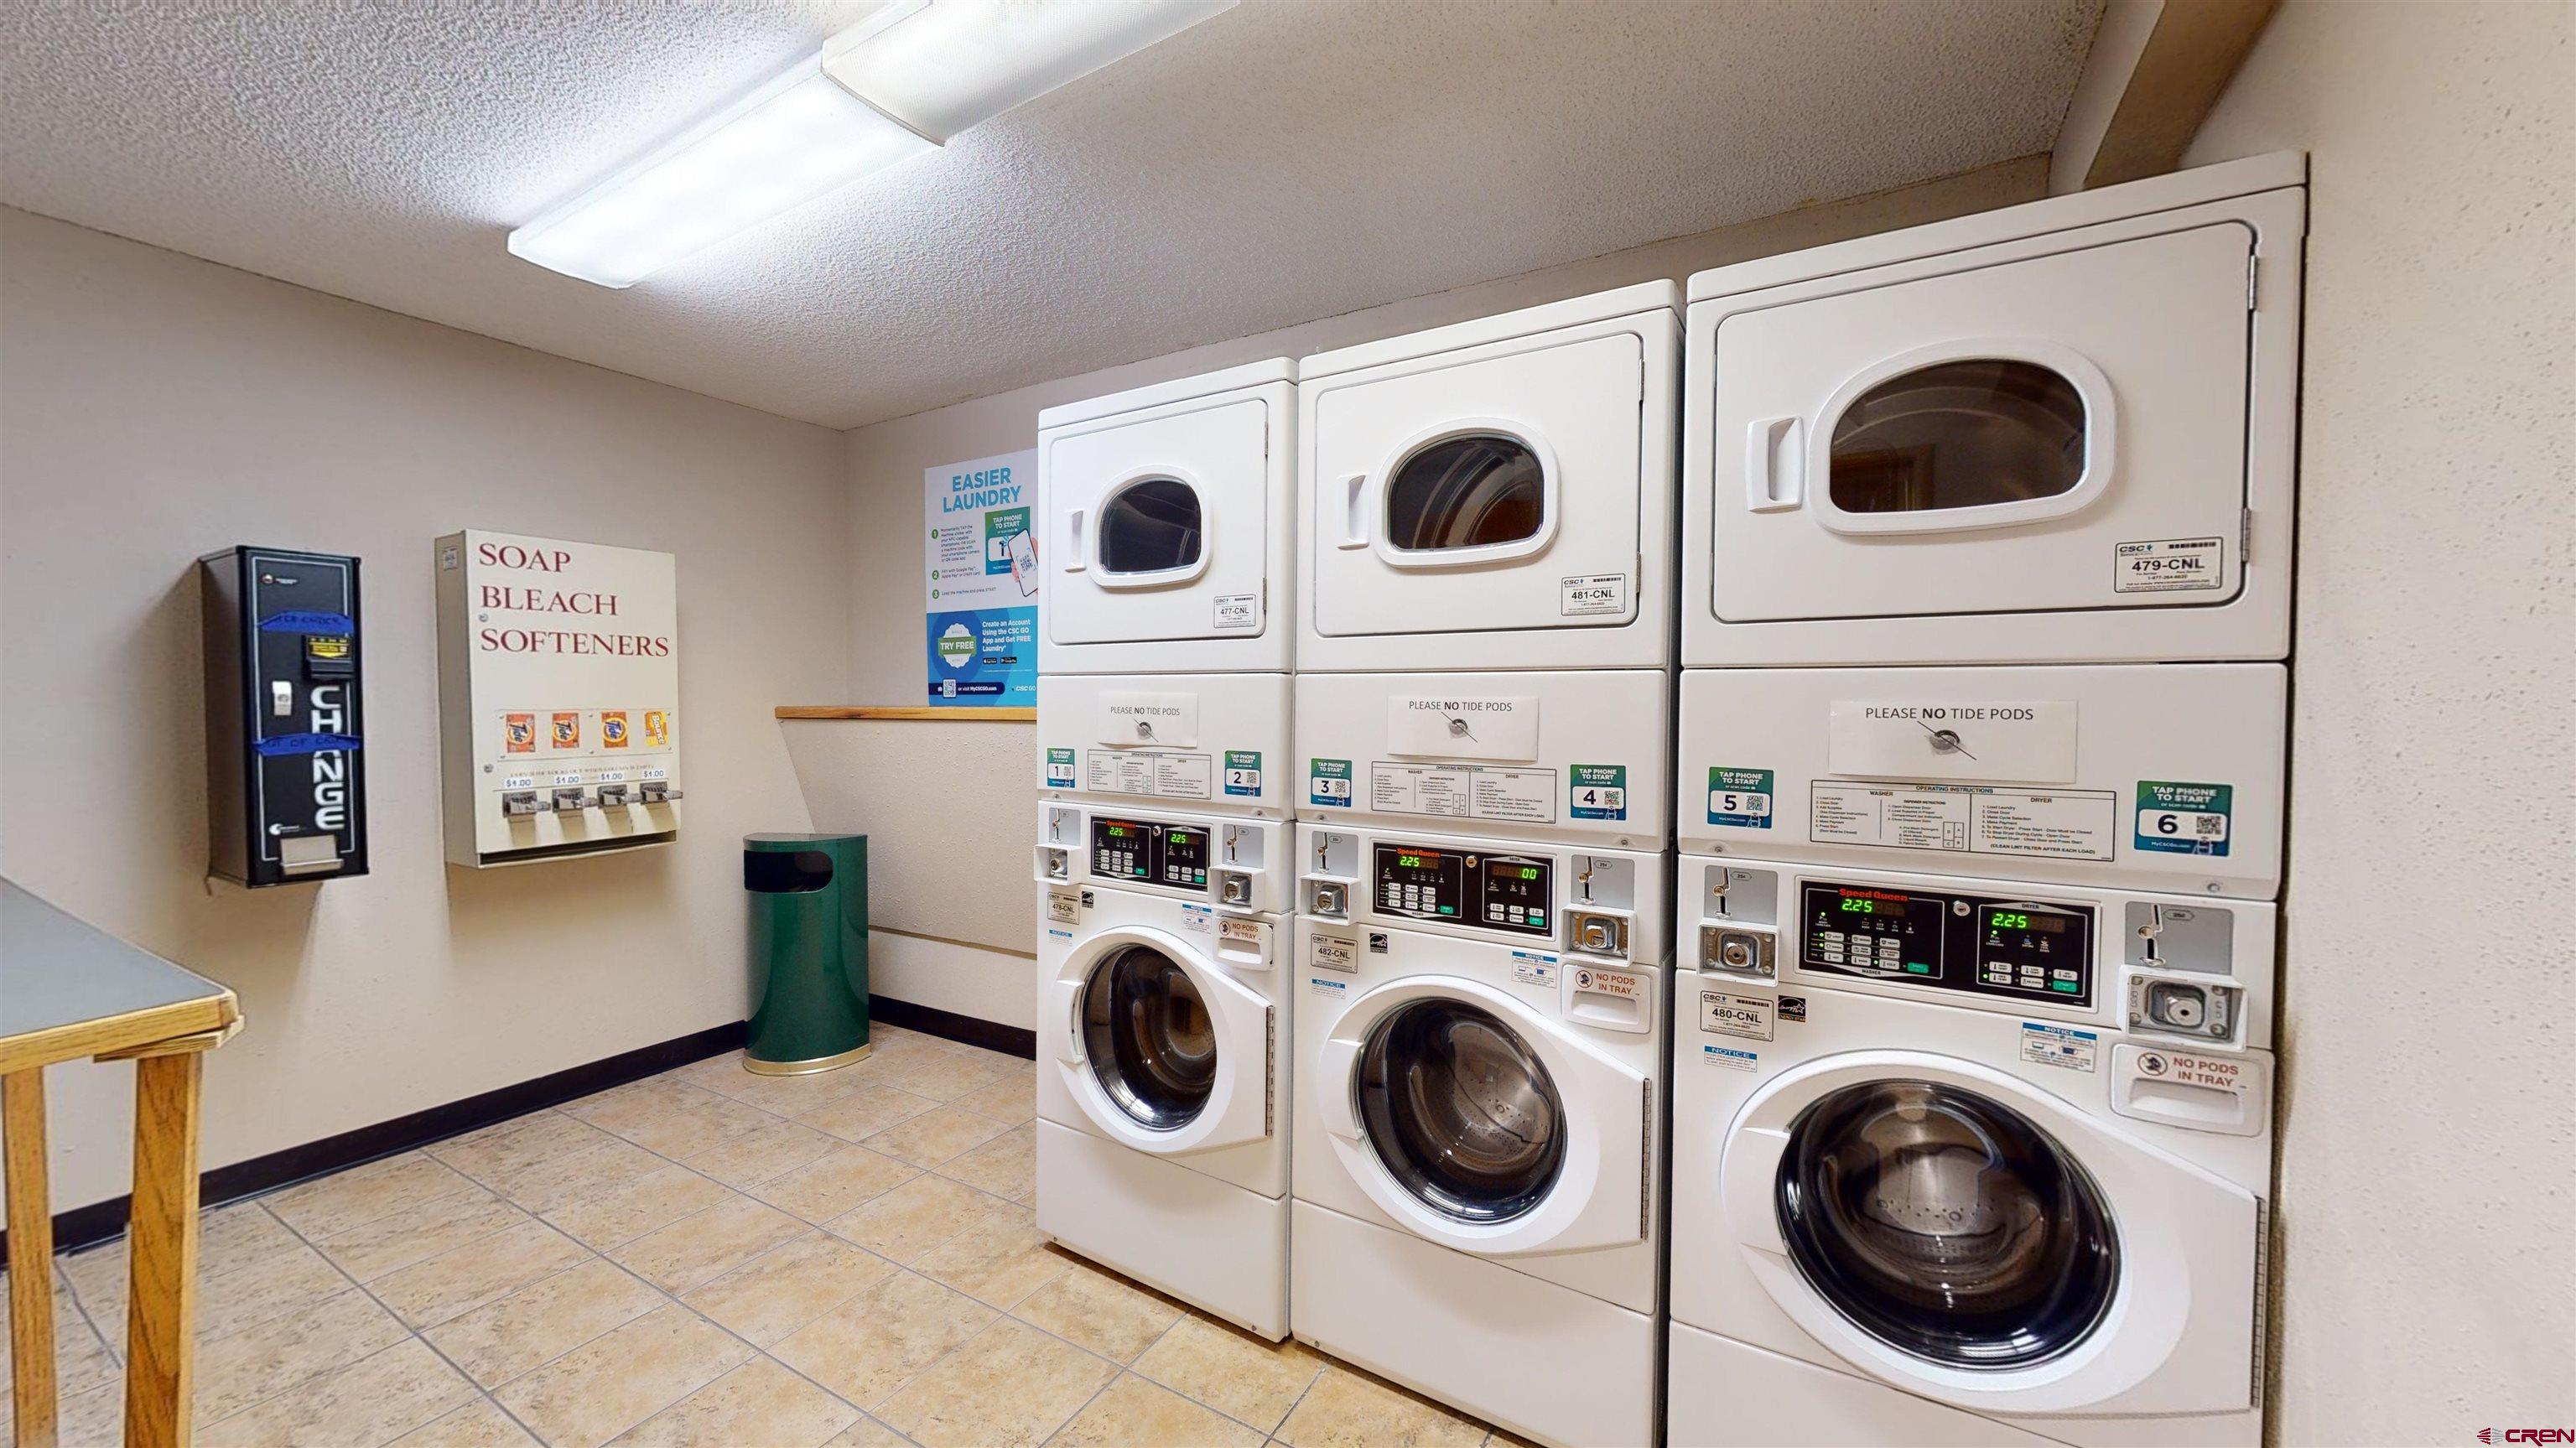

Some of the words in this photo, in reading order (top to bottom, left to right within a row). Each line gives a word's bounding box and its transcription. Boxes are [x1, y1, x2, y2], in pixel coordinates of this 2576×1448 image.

[953, 467, 1011, 491] EASIER
[943, 485, 1021, 513] LAUNDRY
[1003, 520, 1020, 528] START
[999, 541, 1005, 557] 1
[479, 542, 571, 573] SOAP
[2132, 558, 2205, 571] 479-CNL
[480, 585, 617, 615] BLEACH
[1571, 589, 1615, 599] 481-CNL
[480, 628, 669, 657] SOFTENERS
[956, 641, 974, 650] FREE
[1110, 706, 1132, 714] PLEASE
[1146, 707, 1161, 715] TIDE
[1409, 701, 1441, 710] PLEASE
[1444, 701, 1459, 710] NO
[1462, 702, 1483, 711] TIDE
[1486, 702, 1512, 711] PODS
[1866, 708, 1917, 719] PLEASE
[1922, 708, 1946, 719] NO
[1950, 708, 1985, 719] TIDE
[1990, 708, 2033, 720] PODS
[509, 724, 527, 742] Tide
[555, 722, 572, 740] Tide
[605, 720, 621, 739] Tide
[601, 772, 623, 781] $1.00
[643, 770, 664, 778] $1.00
[1055, 766, 1059, 776] 1
[506, 779, 532, 787] $1.00
[556, 776, 579, 784] $1.00
[1233, 771, 1241, 784] 2
[1321, 780, 1329, 793] 3
[2153, 786, 2174, 794] TAP
[2176, 787, 2217, 797] PHONE
[1583, 789, 1597, 805] 4
[1723, 794, 1737, 811] 5
[2174, 795, 2211, 803] START
[2158, 814, 2179, 834] 6
[1396, 848, 1417, 856] Speed
[1418, 849, 1441, 858] Queen
[1400, 856, 1420, 867] 2.25
[1839, 888, 1872, 899] Speed
[1872, 890, 1909, 902] Queen
[1052, 904, 1075, 913] 478-CNL
[1841, 899, 1872, 912] 2.25
[1992, 913, 2027, 928] 2.25
[1242, 924, 1259, 932] PODS
[1318, 947, 1350, 959] 482-CNL
[1596, 973, 1609, 981] NO
[1611, 975, 1635, 985] PODS
[1609, 984, 1632, 994] TRAY
[1712, 1008, 1763, 1023] 480-CNL
[2044, 1026, 2075, 1036] NOTICE
[1711, 1047, 1751, 1058] NOTICE
[2174, 1057, 2194, 1068] NO
[2199, 1061, 2239, 1075] PODS
[2178, 1071, 2192, 1080] IN
[2196, 1073, 2233, 1087] TRAY
